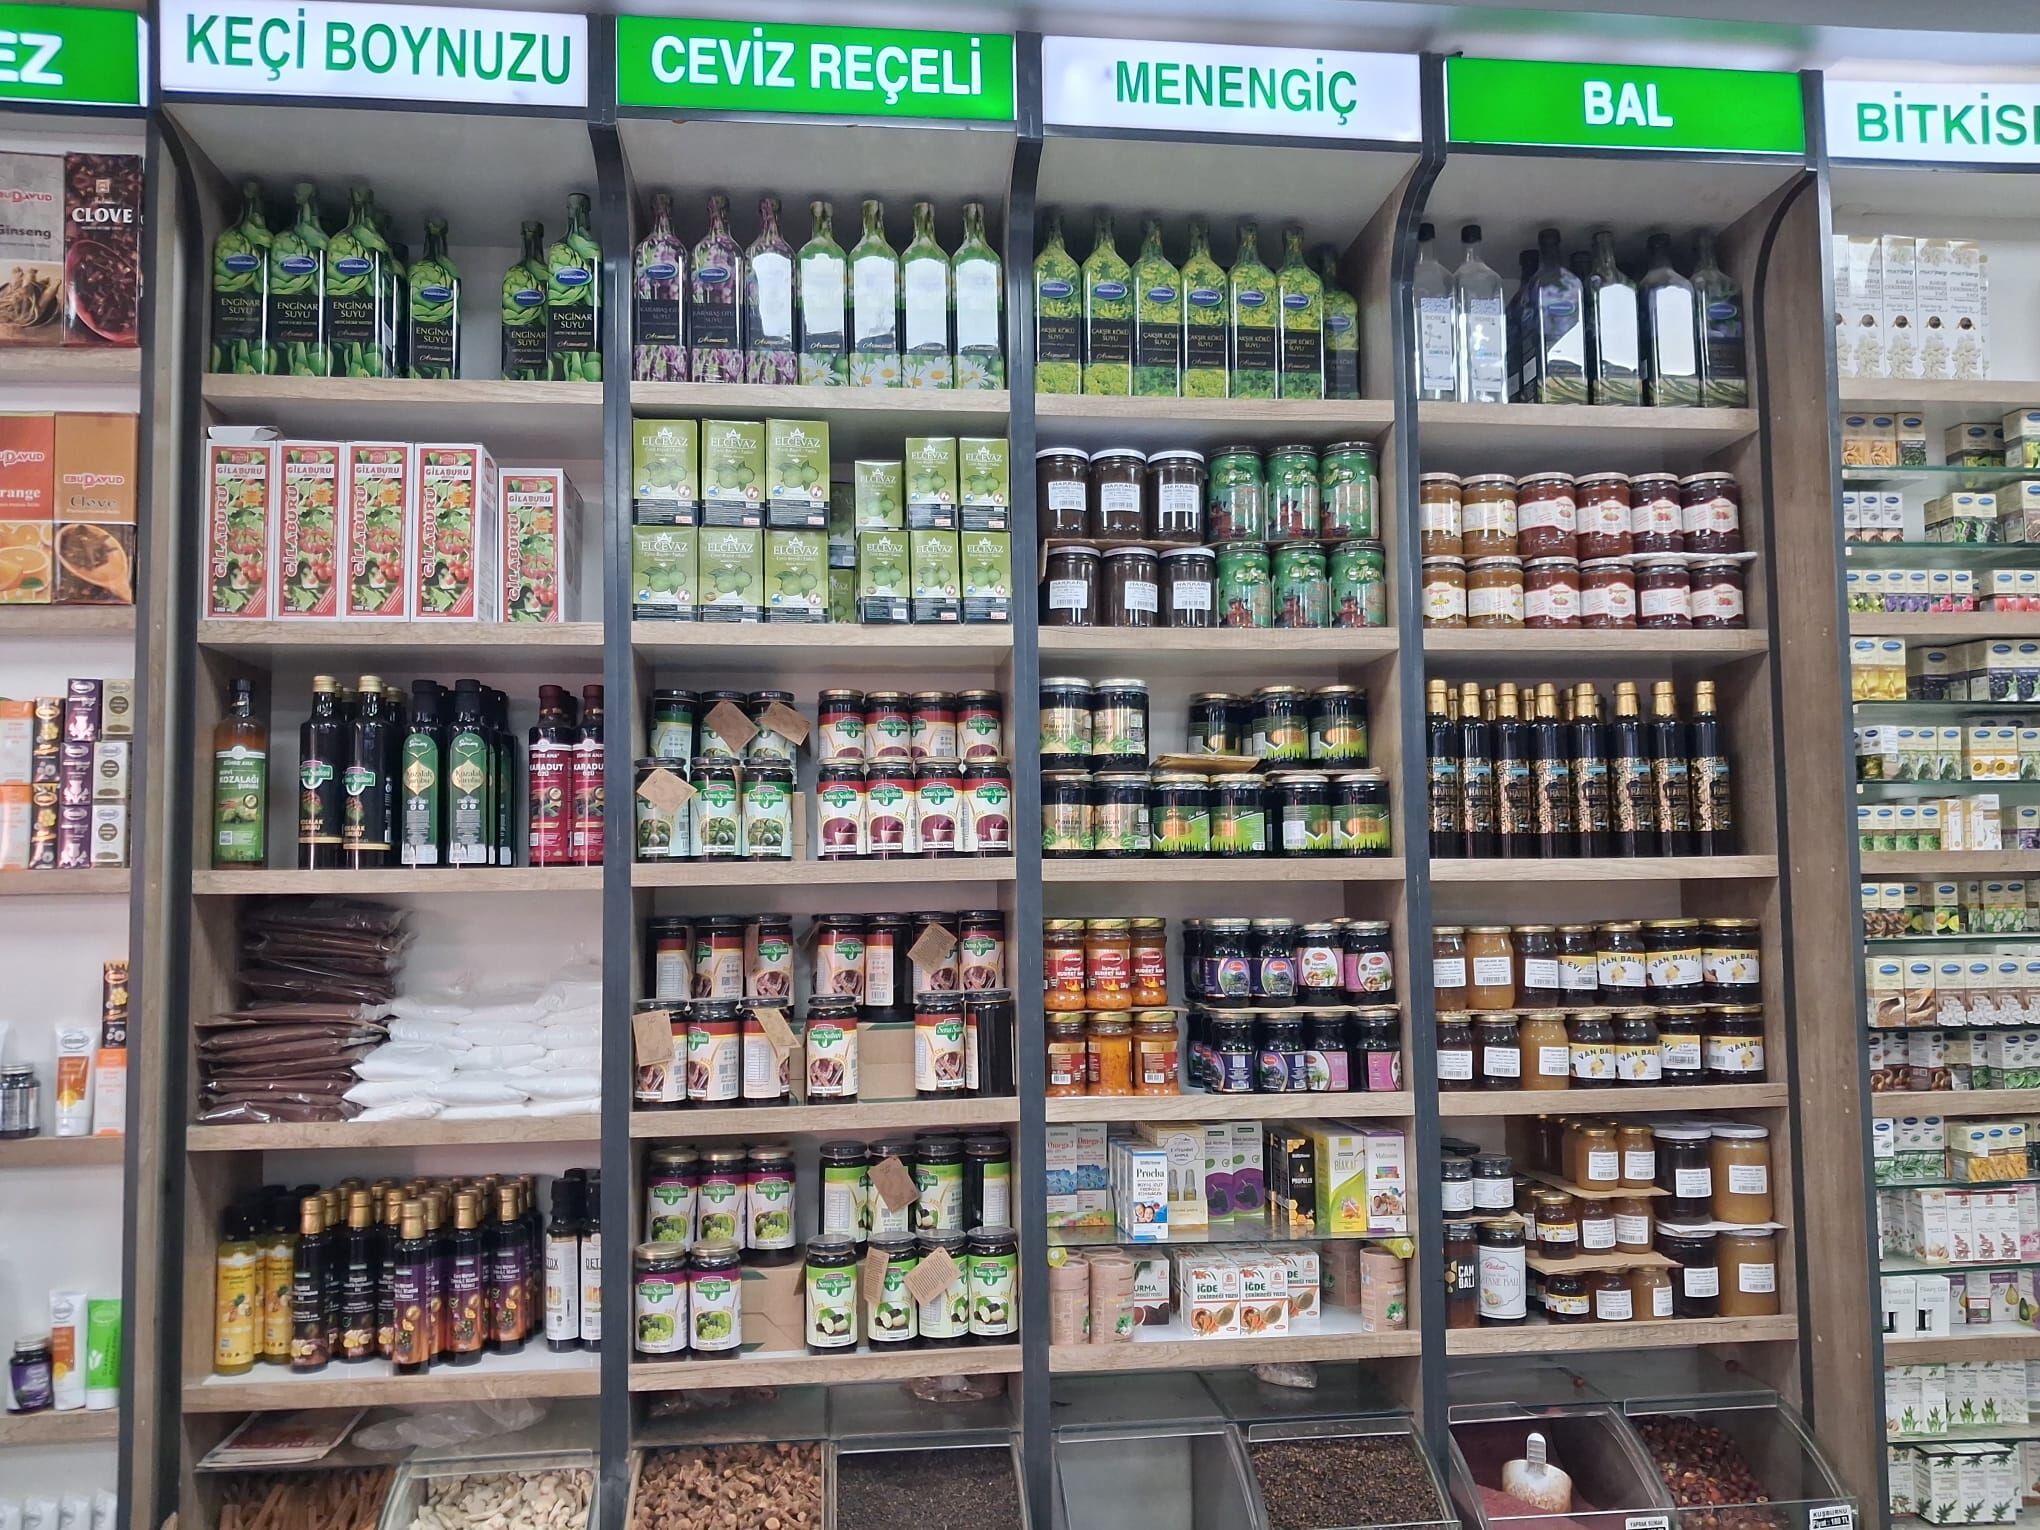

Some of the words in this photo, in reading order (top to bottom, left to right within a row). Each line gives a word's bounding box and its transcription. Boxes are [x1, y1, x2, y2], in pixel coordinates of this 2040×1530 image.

[186, 8, 306, 80] KEÇİ
[325, 21, 571, 85] BOYNUZU
[651, 27, 795, 88] CEVİZ
[810, 38, 981, 104] REÇELİ
[1116, 58, 1357, 125] MENENGİÇ
[1583, 81, 1674, 128] BAL
[71, 207, 134, 225] CLOVE
[277, 300, 319, 311] ENGİNAR
[333, 300, 374, 311] ENGİNAR
[285, 310, 311, 319] SUYU
[340, 310, 366, 319] SUYU
[553, 311, 592, 321] ENGİNAR
[560, 320, 585, 329] SUYU
[642, 437, 688, 447] ELCEVAZ
[711, 438, 757, 449] ELCEVAZ
[775, 437, 820, 448] ELCEVAZ
[912, 451, 948, 461] ELCEVAZ
[966, 453, 1002, 462] ELCEVAZ
[217, 465, 263, 475] GİLABURU
[287, 465, 332, 475] GİLABURU
[356, 465, 400, 475] GİLABURU
[425, 467, 469, 477] GİLABURU
[0, 488, 41, 501] range
[509, 494, 551, 504] GİLABURU
[214, 486, 230, 578] GİLABURU
[284, 486, 299, 578] GİLABURU
[353, 486, 368, 577] GİLABURU
[422, 488, 437, 578] GİLABURU
[641, 541, 688, 552] ELCEVAZ
[707, 543, 754, 553] ELCEVAZ
[773, 545, 819, 556] ELCEVAZ
[867, 544, 903, 553] ELCEVAZ
[916, 545, 952, 554] ELCEVAZ
[967, 545, 1003, 554] ELCEVAZ
[507, 513, 522, 603] GİLABURU
[574, 763, 603, 772] KARADU
[1600, 955, 1617, 967] VAN
[1620, 955, 1638, 963] BAL
[1653, 956, 1670, 968] VAN
[1672, 954, 1689, 962] BAL
[1719, 955, 1738, 966] VAN
[1728, 1042, 1746, 1053] VAN
[1578, 1048, 1597, 1060] VAN
[1620, 1050, 1638, 1062] VAN
[546, 1258, 559, 1270] TOX
[586, 1258, 602, 1270] DET
[1287, 1271, 1299, 1279] DE
[1458, 1265, 1475, 1278] CAM
[1197, 1283, 1218, 1293] İĞDE
[1245, 1281, 1266, 1291] İĞDE
[1458, 1277, 1475, 1289] BALI
